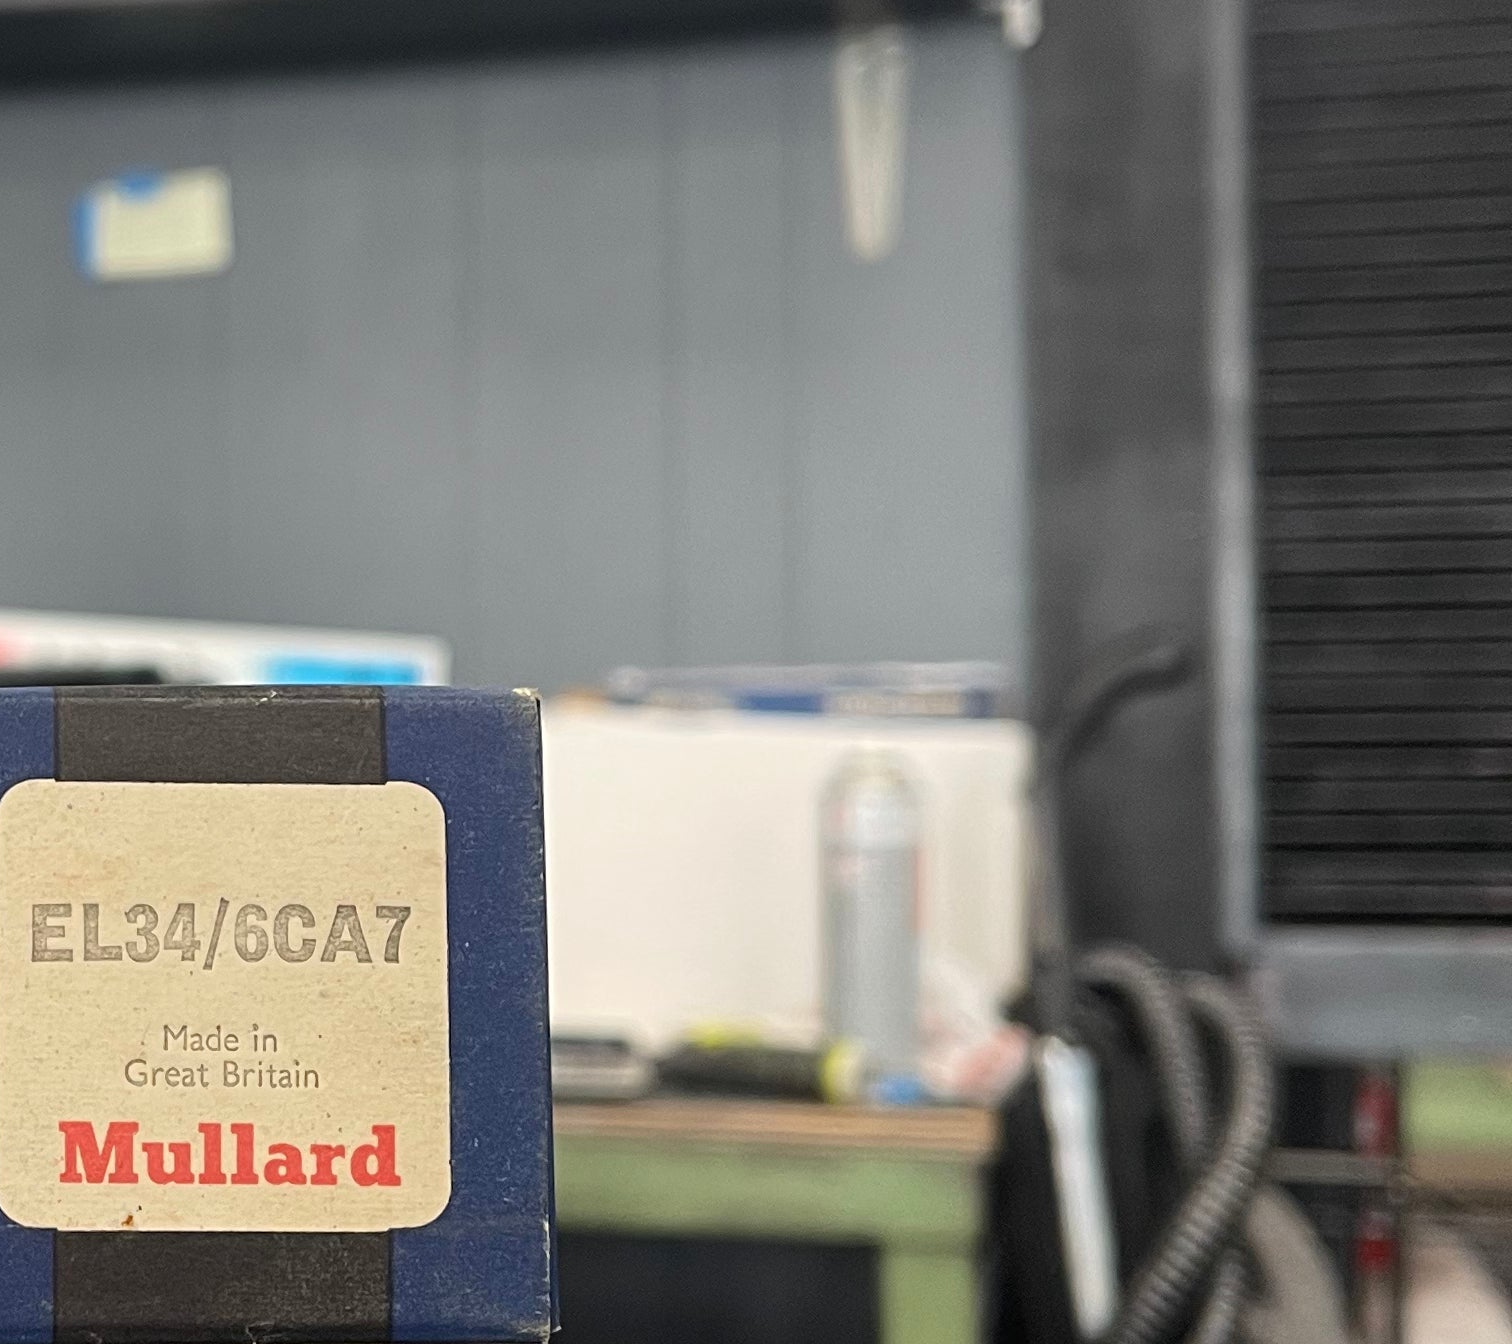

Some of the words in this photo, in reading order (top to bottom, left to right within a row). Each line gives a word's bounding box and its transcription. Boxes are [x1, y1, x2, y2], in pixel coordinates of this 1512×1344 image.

[30, 897, 413, 971] EL34/6CA7
[162, 1023, 240, 1052] Made
[252, 1023, 278, 1052] in
[123, 1058, 210, 1089] Great
[222, 1059, 320, 1089] Britain
[58, 1120, 402, 1187] Mullard
